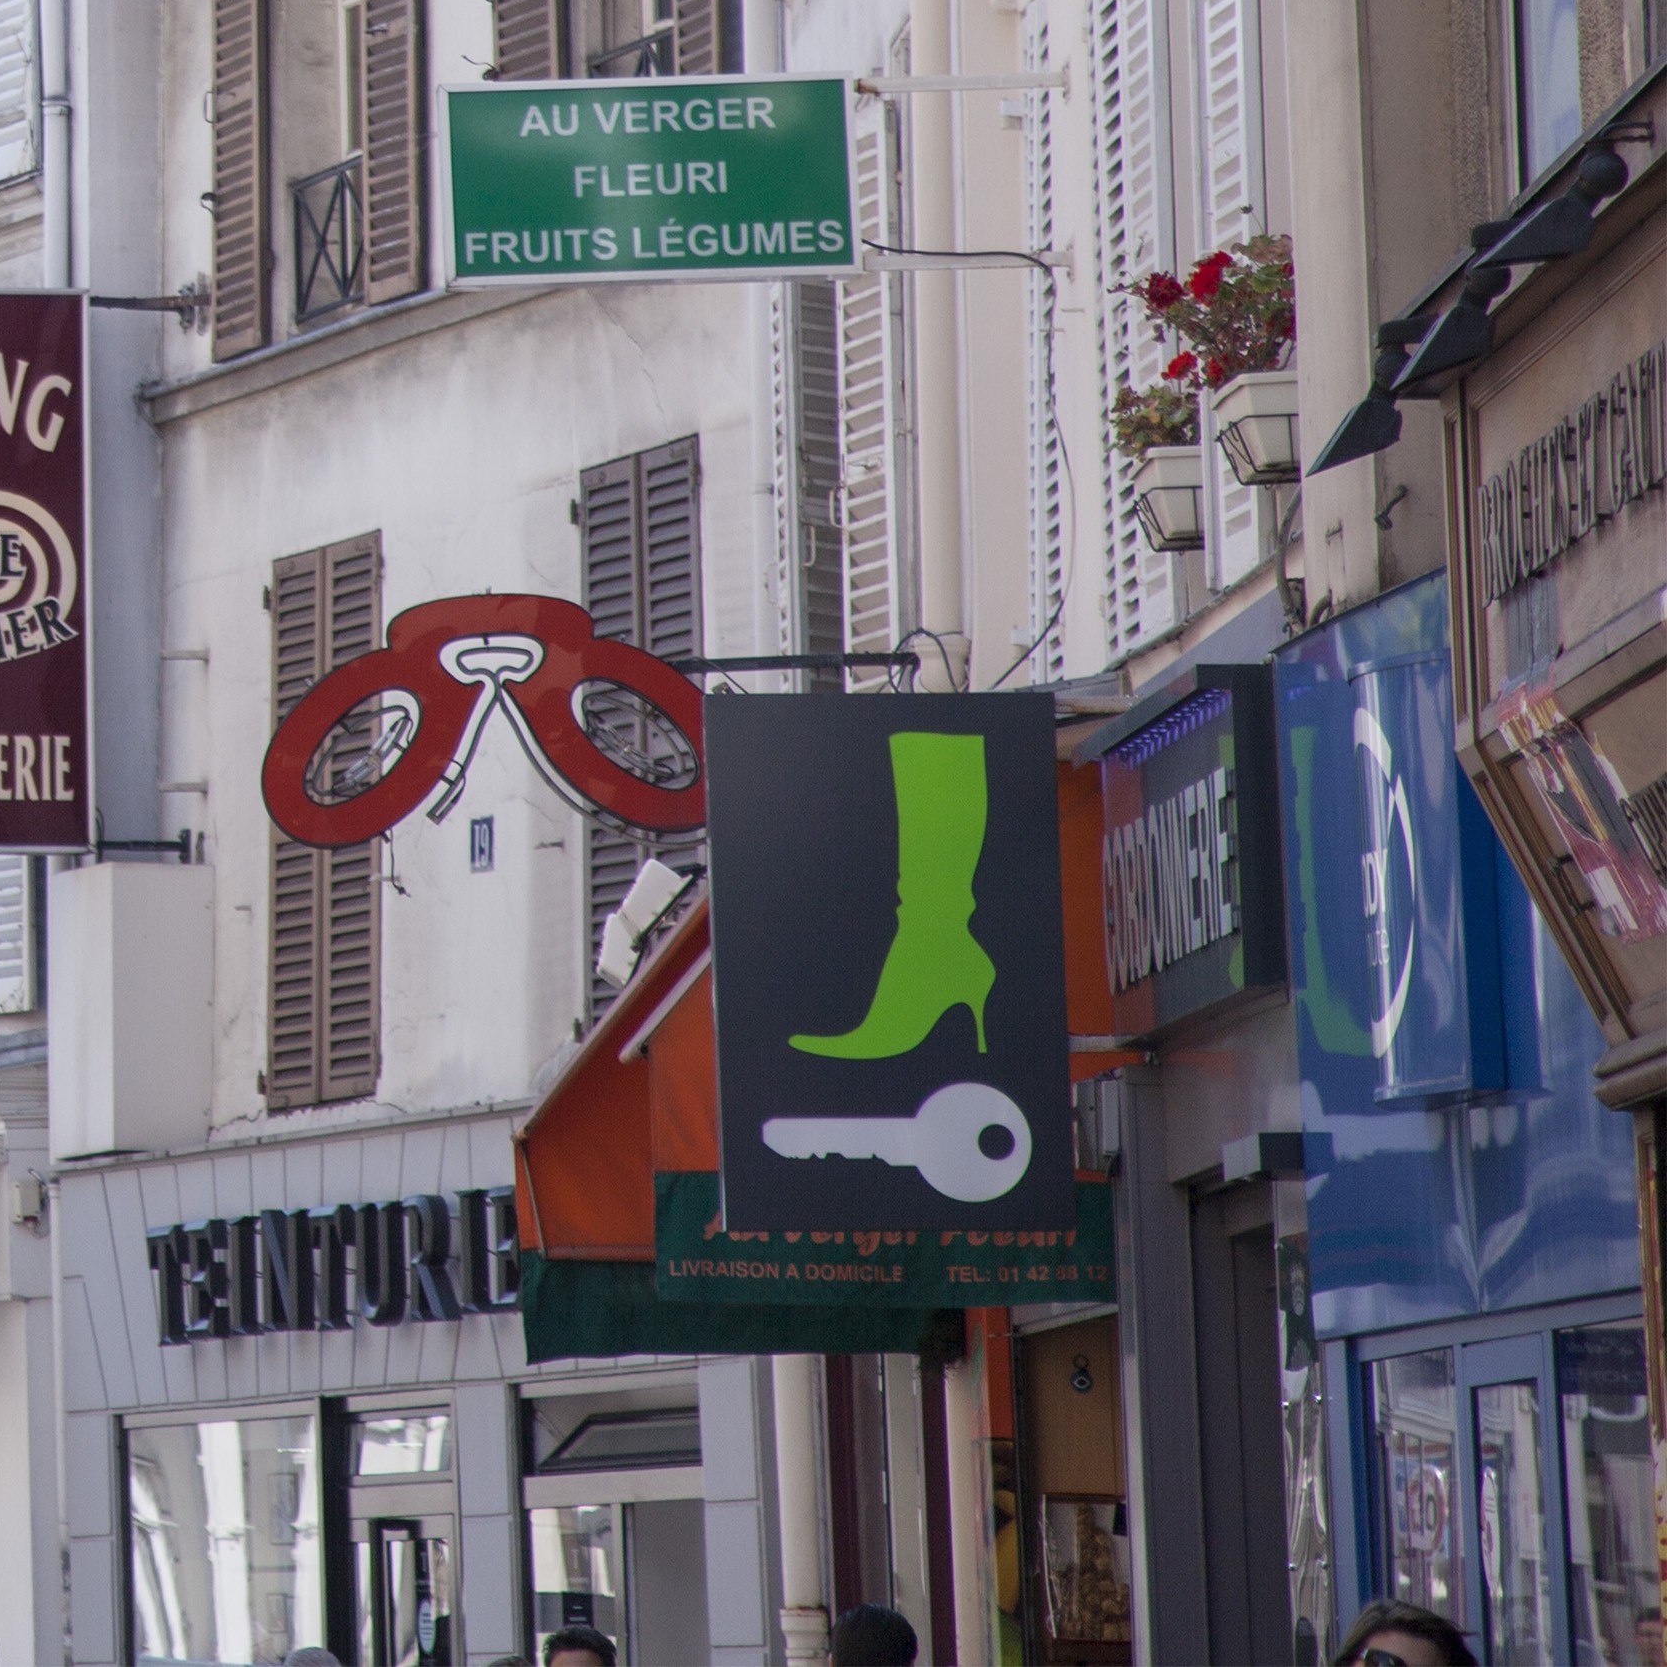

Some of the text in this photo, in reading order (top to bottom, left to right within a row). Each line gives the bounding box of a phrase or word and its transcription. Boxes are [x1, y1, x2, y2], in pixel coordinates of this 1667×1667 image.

[519, 96, 776, 138] AU VERGER
[574, 161, 728, 198] FLEURI
[464, 218, 845, 265] FRUITS LÉGUMES
[1576, 392, 1601, 539] ET
[472, 822, 490, 869] 19
[1102, 767, 1233, 997] CORDONNERIE
[669, 1260, 780, 1279] LIVRAISON
[785, 1263, 800, 1280] A
[805, 1263, 904, 1283] DOMICILE
[946, 1265, 991, 1283] TEL:
[1027, 1265, 1050, 1282] 42
[1086, 1265, 1108, 1282] 12
